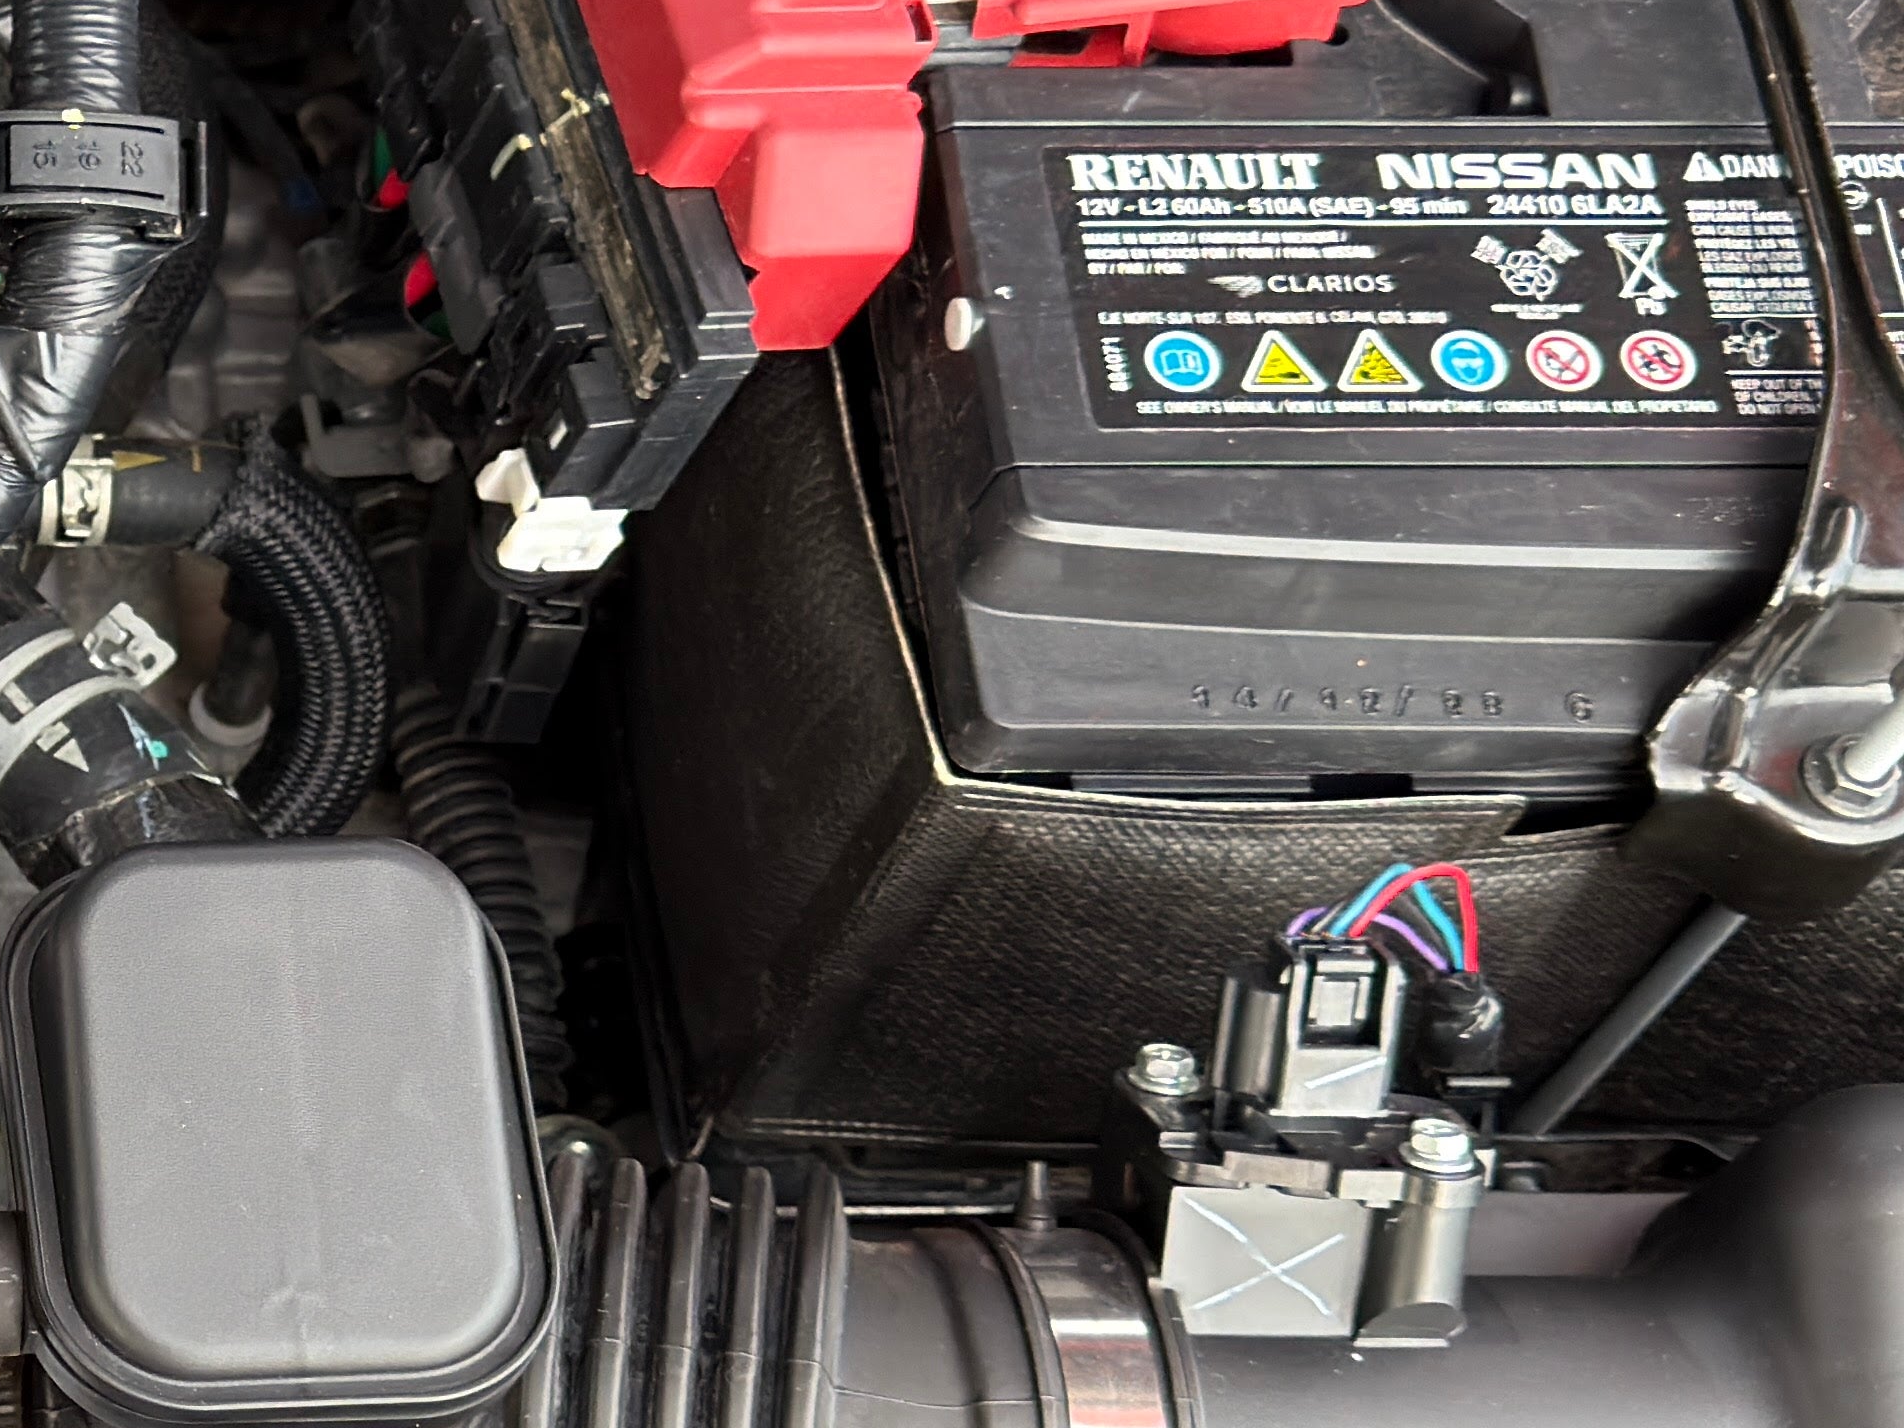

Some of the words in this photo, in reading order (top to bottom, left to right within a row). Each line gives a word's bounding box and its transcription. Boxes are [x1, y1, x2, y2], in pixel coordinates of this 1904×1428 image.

[1066, 153, 1321, 191] RENAULT
[1376, 153, 1658, 190] NISSAN
[1720, 154, 1780, 179] DAN
[1076, 197, 1120, 217] 12V
[1172, 197, 1231, 216] 60Ah
[1247, 197, 1307, 216] 510A
[1310, 197, 1375, 219] (SAE)
[1390, 197, 1420, 216] 95
[1423, 197, 1470, 215] min
[1487, 194, 1570, 216] 24410
[1267, 274, 1396, 293] CLARIOS
